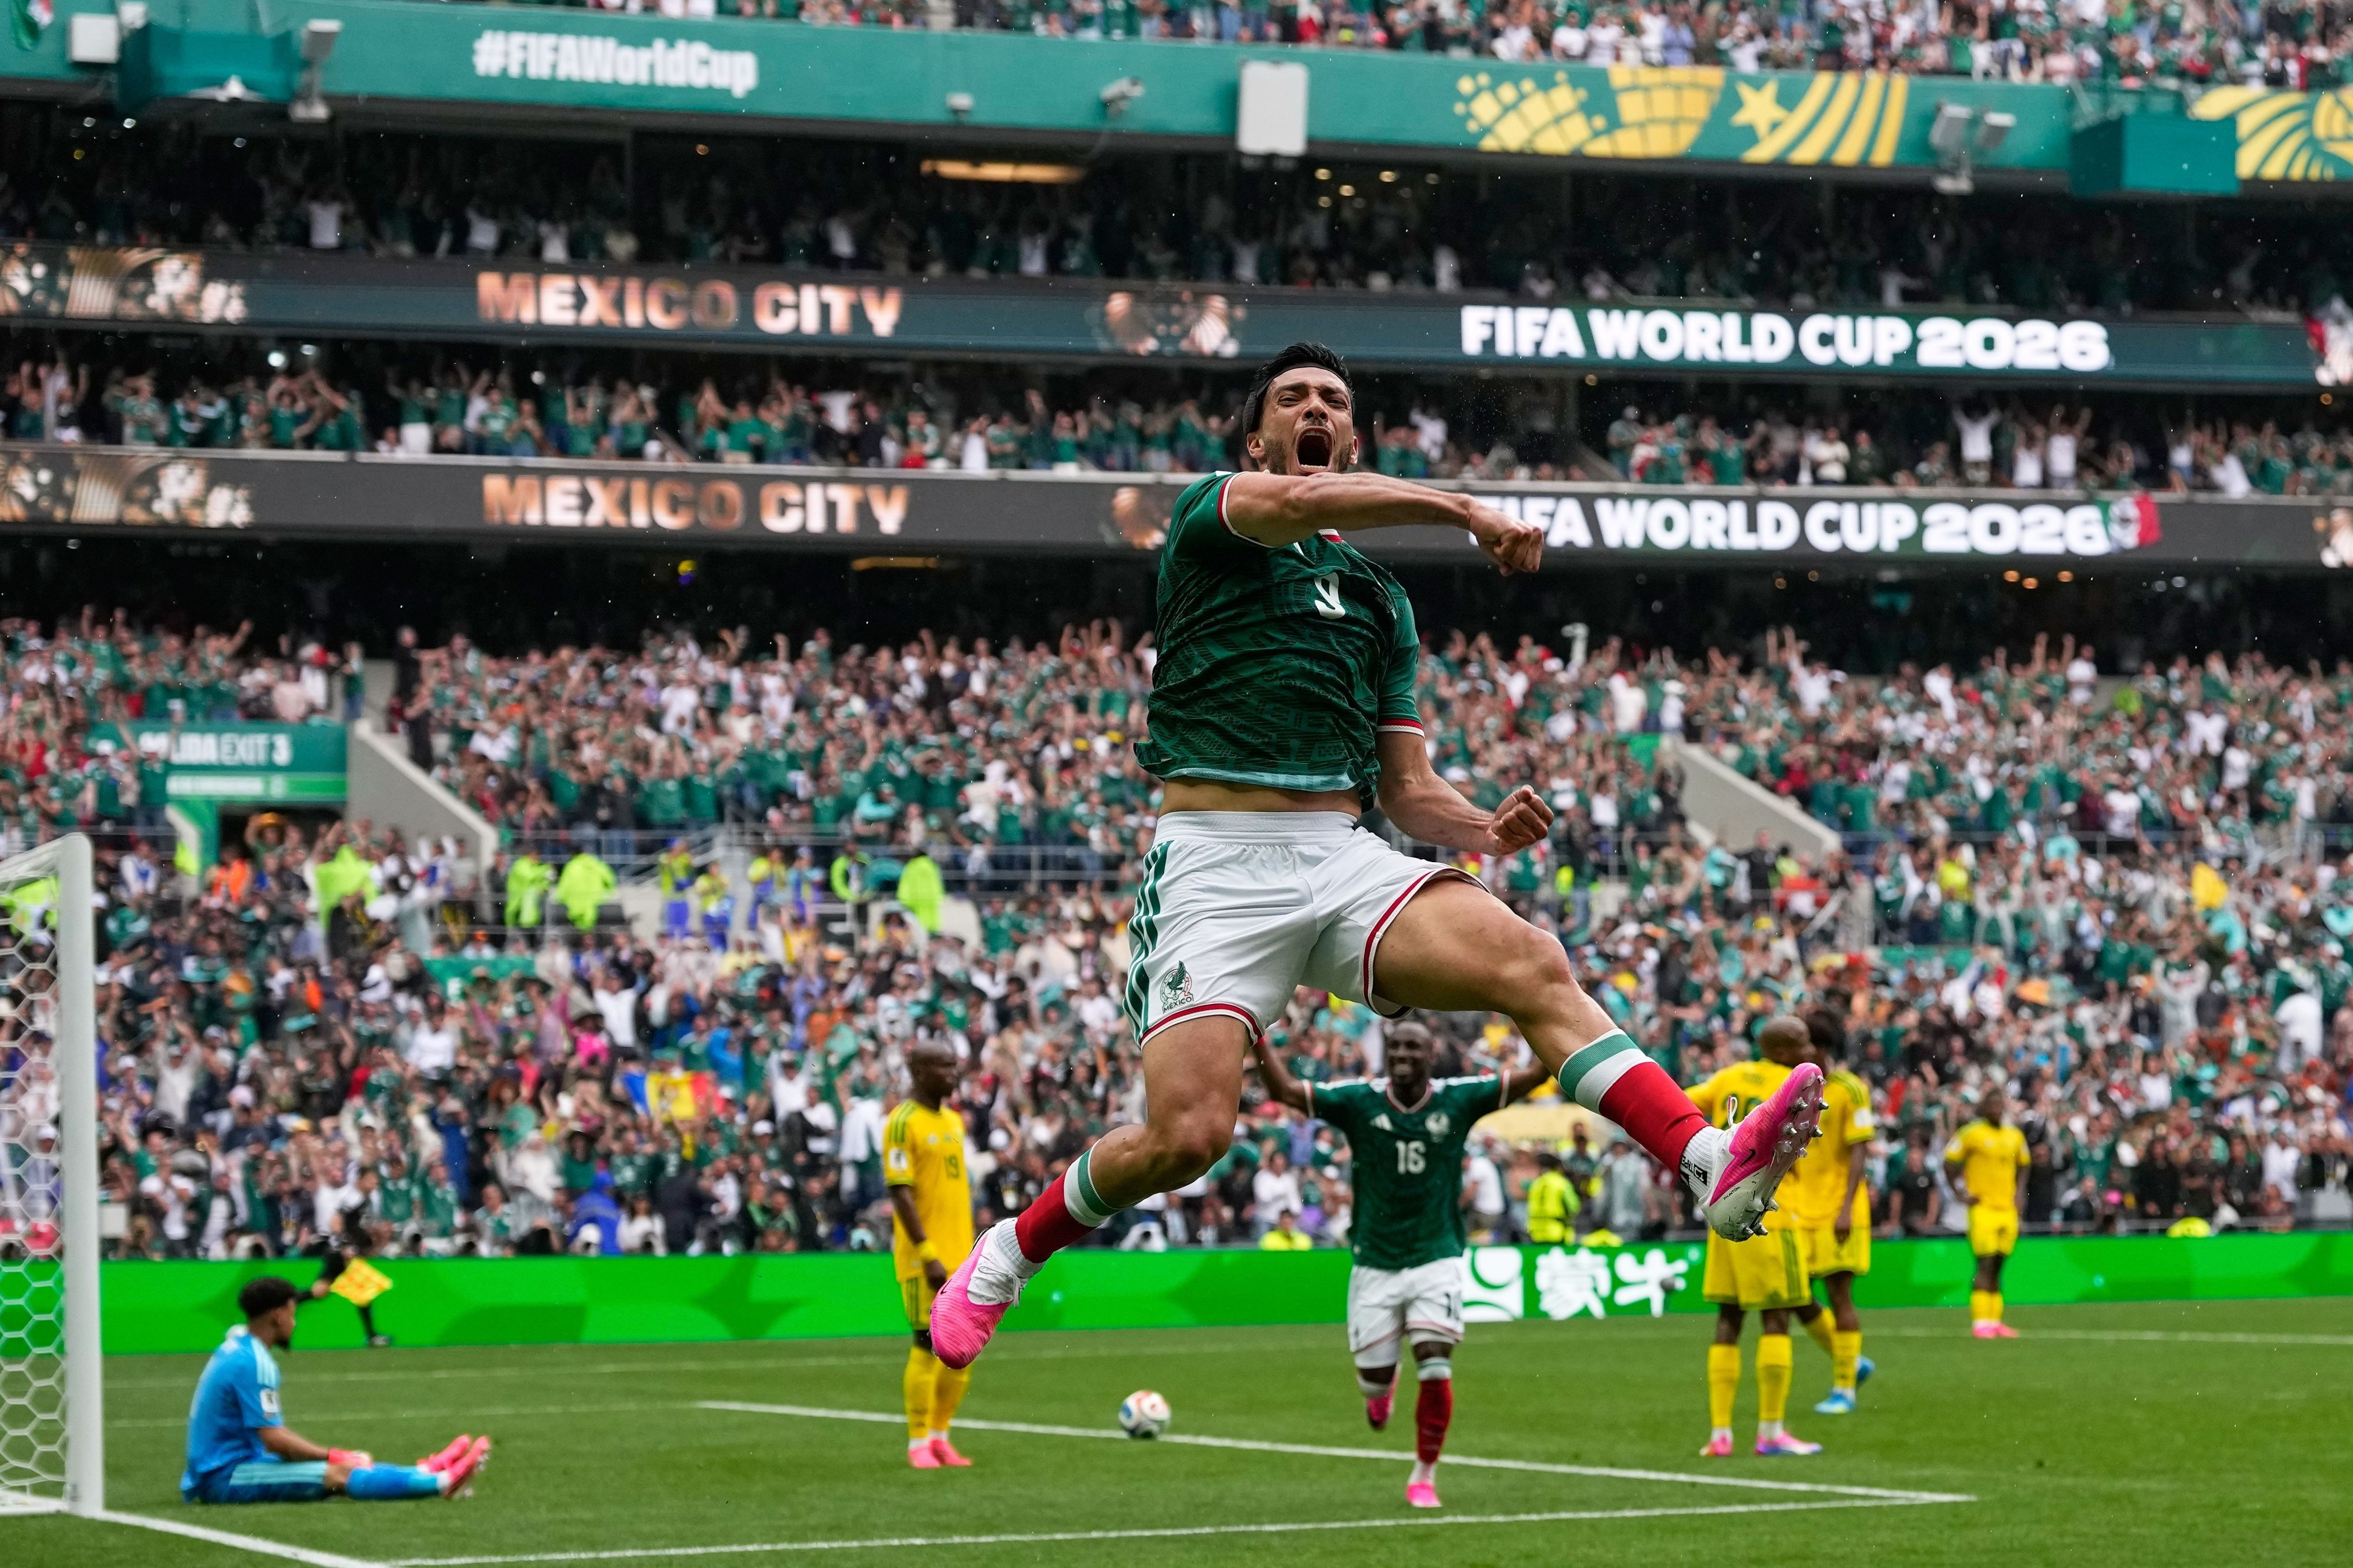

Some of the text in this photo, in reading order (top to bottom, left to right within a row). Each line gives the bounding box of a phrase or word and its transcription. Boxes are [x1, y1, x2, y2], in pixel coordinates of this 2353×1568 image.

[473, 30, 758, 98] #FIFAWorldCup
[476, 271, 903, 338] MEXICO CITY
[1461, 305, 2111, 372] FIFA WORLD CUP 2026
[481, 473, 910, 535] MEXICO CITY
[1594, 498, 1801, 551] WORLD
[1804, 500, 1918, 554] CUP
[1921, 503, 2111, 556] 2026
[219, 732, 270, 766] EXIT
[272, 733, 293, 767] 3
[944, 1154, 960, 1179] 19
[1395, 1139, 1427, 1175] 16
[1723, 1186, 1741, 1200] PHANTOM
[1535, 1246, 1689, 1320] 蒙牛
